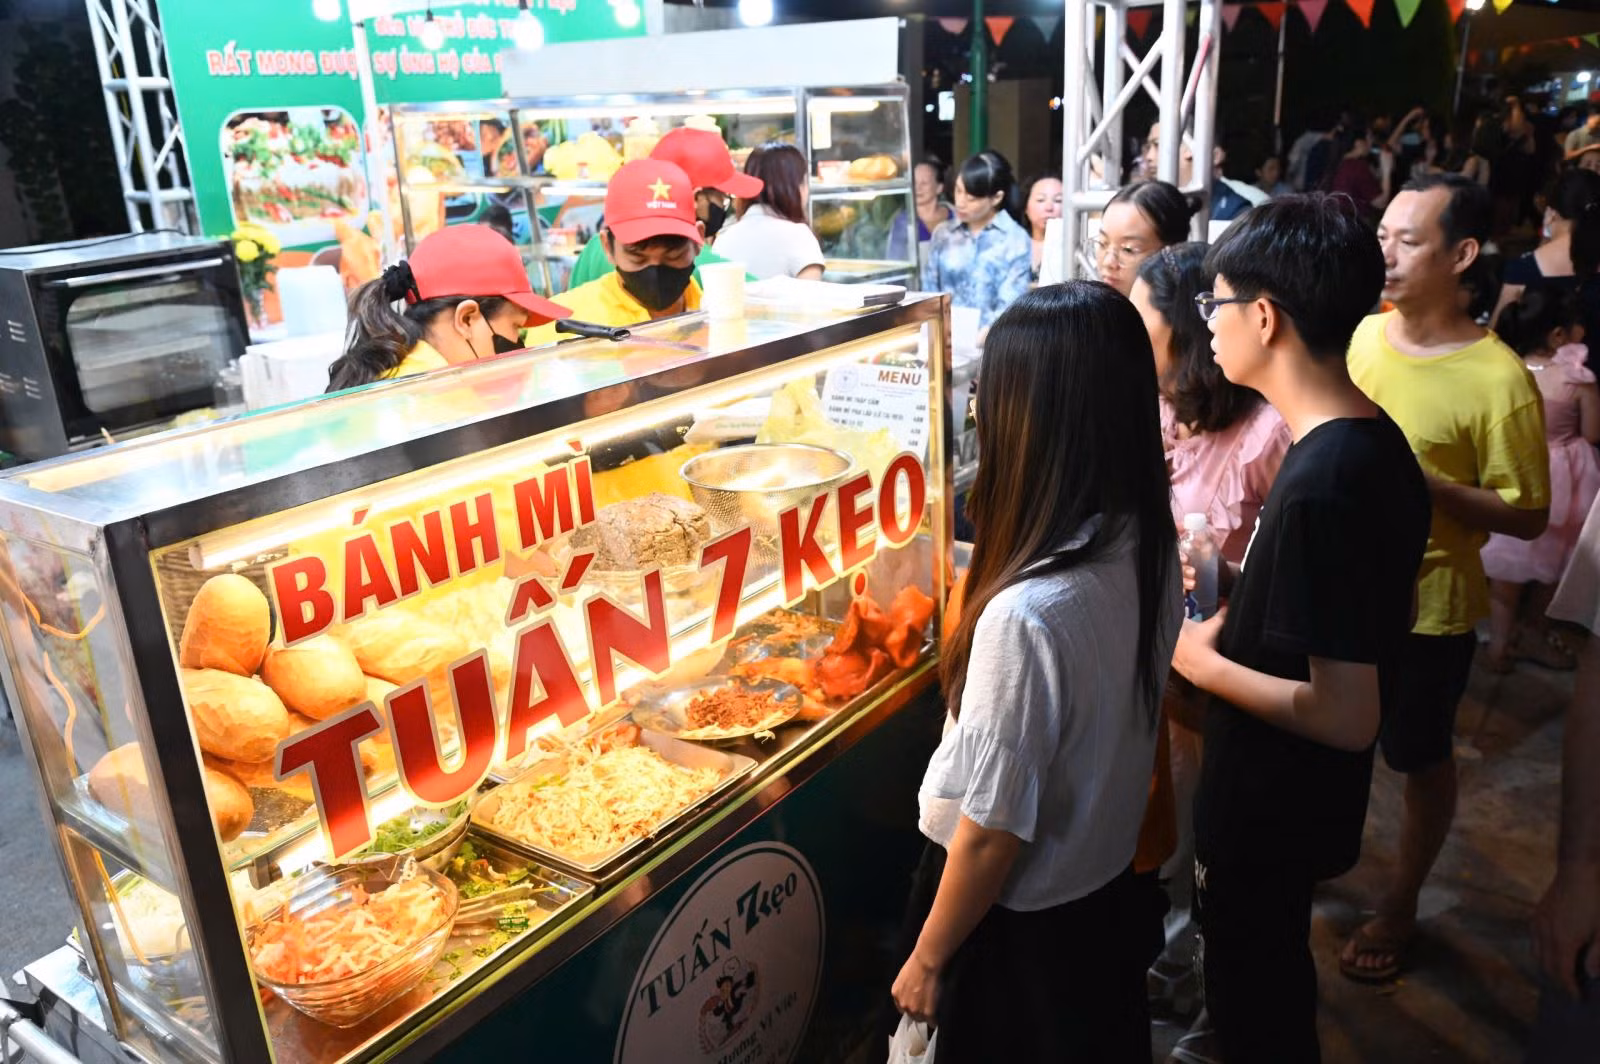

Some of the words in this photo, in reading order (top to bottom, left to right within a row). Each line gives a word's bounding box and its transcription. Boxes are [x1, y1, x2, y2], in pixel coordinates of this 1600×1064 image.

[207, 40, 252, 76] RẤT
[256, 50, 318, 76] MONG
[320, 47, 358, 80] ĐƯỢ
[878, 370, 922, 386] MENU
[271, 507, 501, 646] BÁNH
[512, 440, 597, 552] MÌ
[276, 550, 673, 863] TUẤN
[699, 526, 752, 645] 7
[778, 453, 927, 606] KẸO
[640, 918, 732, 1018] TUẤN
